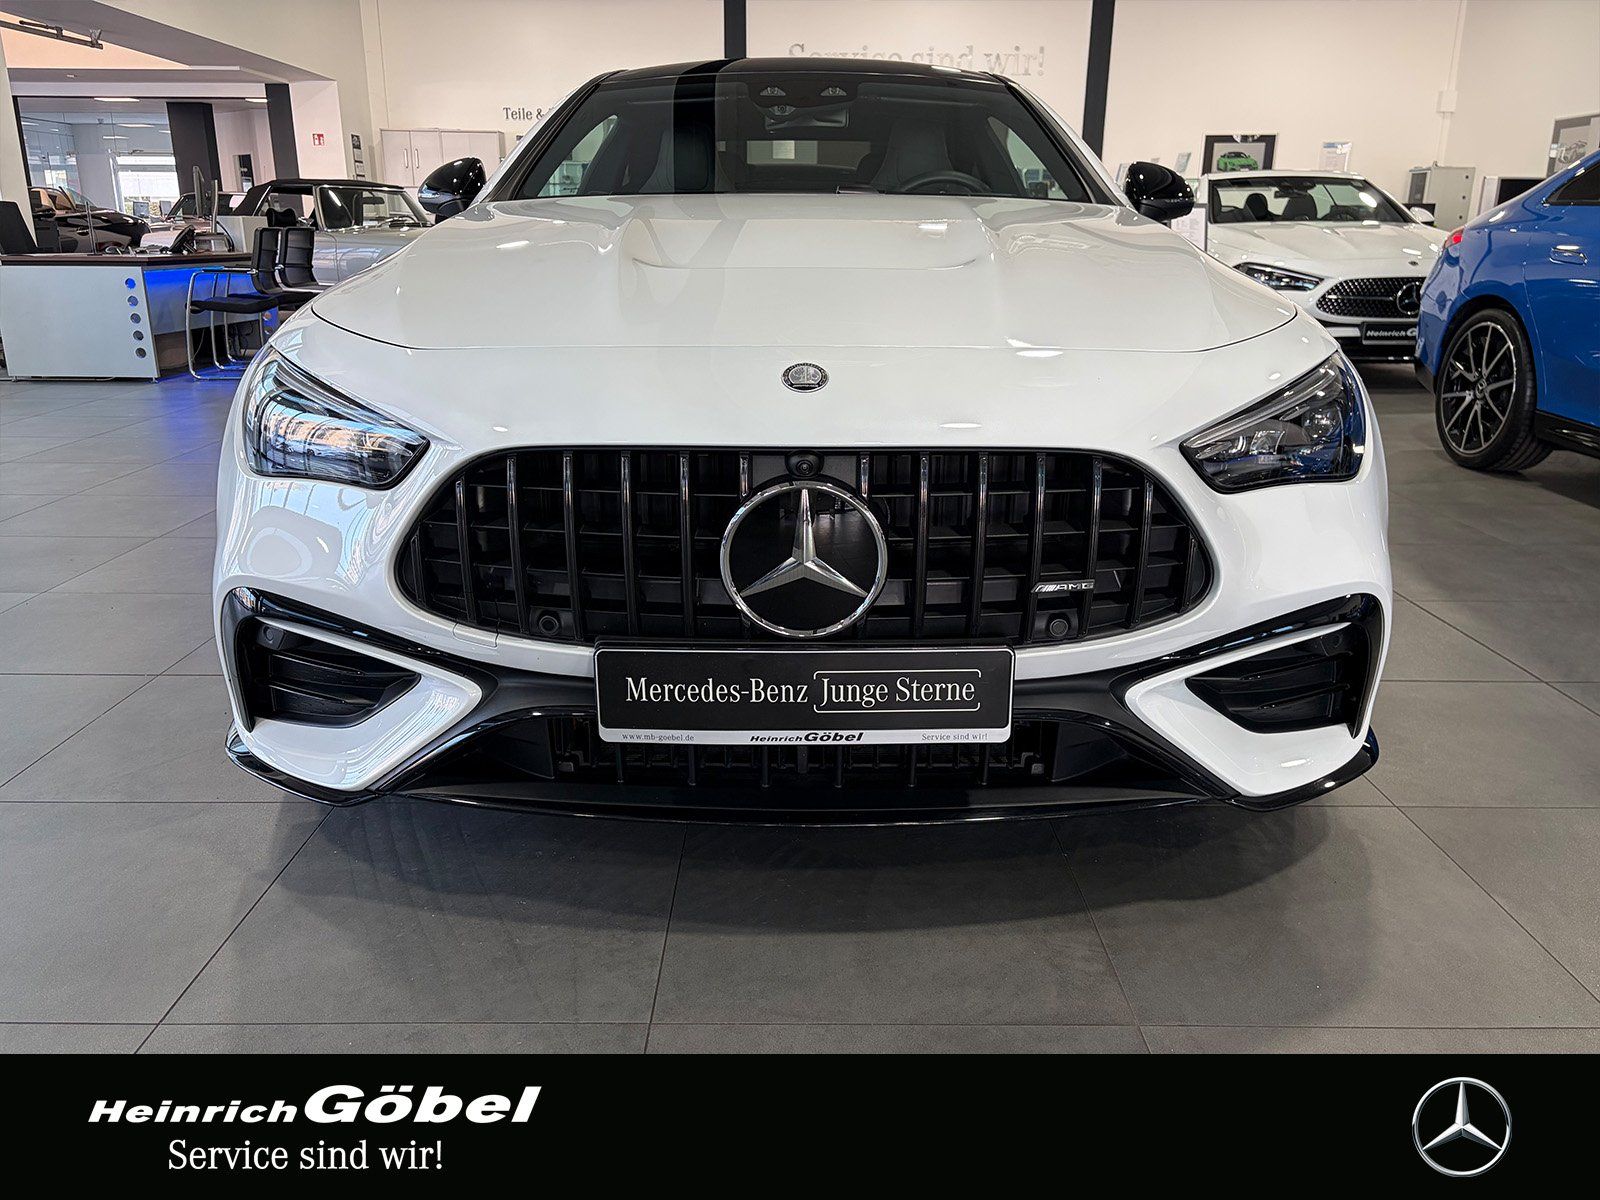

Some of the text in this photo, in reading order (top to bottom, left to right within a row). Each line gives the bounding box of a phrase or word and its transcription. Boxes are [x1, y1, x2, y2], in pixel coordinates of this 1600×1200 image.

[503, 107, 545, 120] Teile &
[1053, 582, 1094, 591] AMG
[626, 676, 975, 708] Mercedes-Benz Junge Sterne
[621, 732, 695, 742] www.mb-goebel.de
[804, 732, 864, 742] Göbel
[921, 732, 988, 741] Service sind wir!
